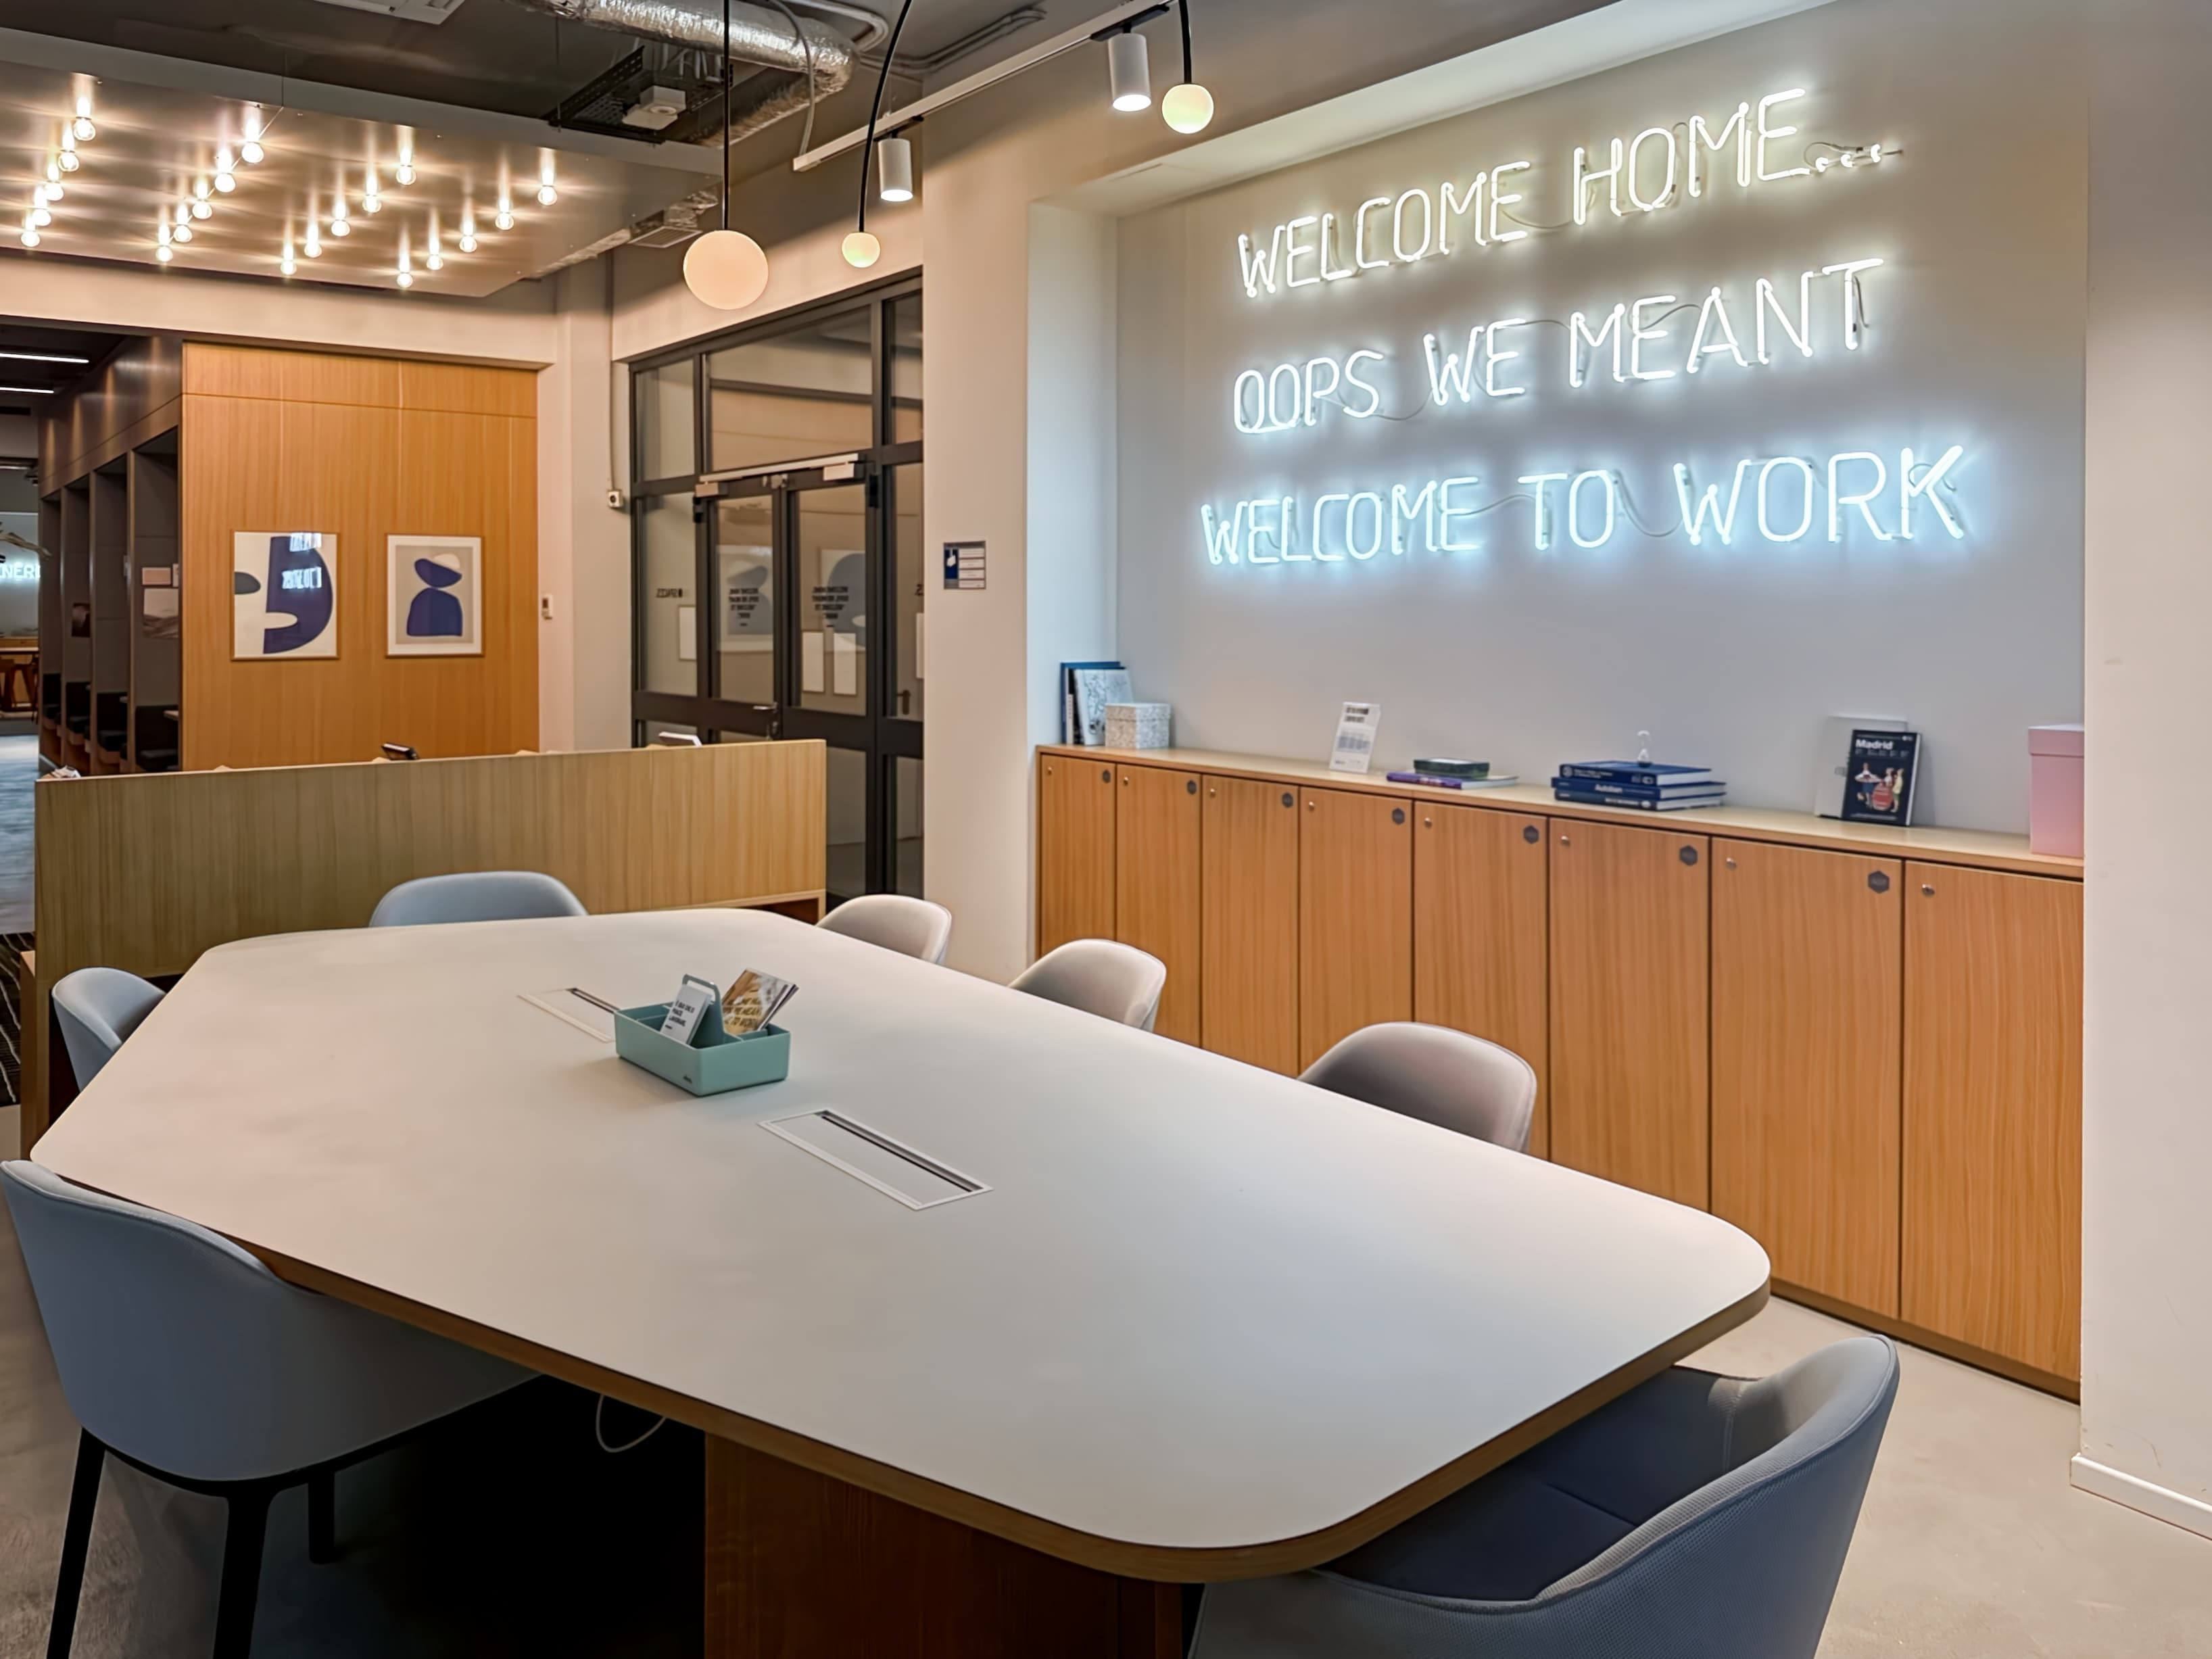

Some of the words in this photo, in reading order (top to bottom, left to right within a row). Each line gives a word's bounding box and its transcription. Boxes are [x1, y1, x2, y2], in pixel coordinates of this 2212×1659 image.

[1238, 161, 1531, 297] WELCOME
[1573, 89, 1880, 225] HOME...
[1234, 350, 1383, 433] OOPS
[1424, 318, 1526, 406] WE
[1570, 258, 1884, 388] MEANT
[1201, 476, 1478, 565] WELCOME
[1518, 470, 1615, 550] TO
[1673, 445, 1964, 546] WORK
[1856, 740, 1893, 749] Madrid
